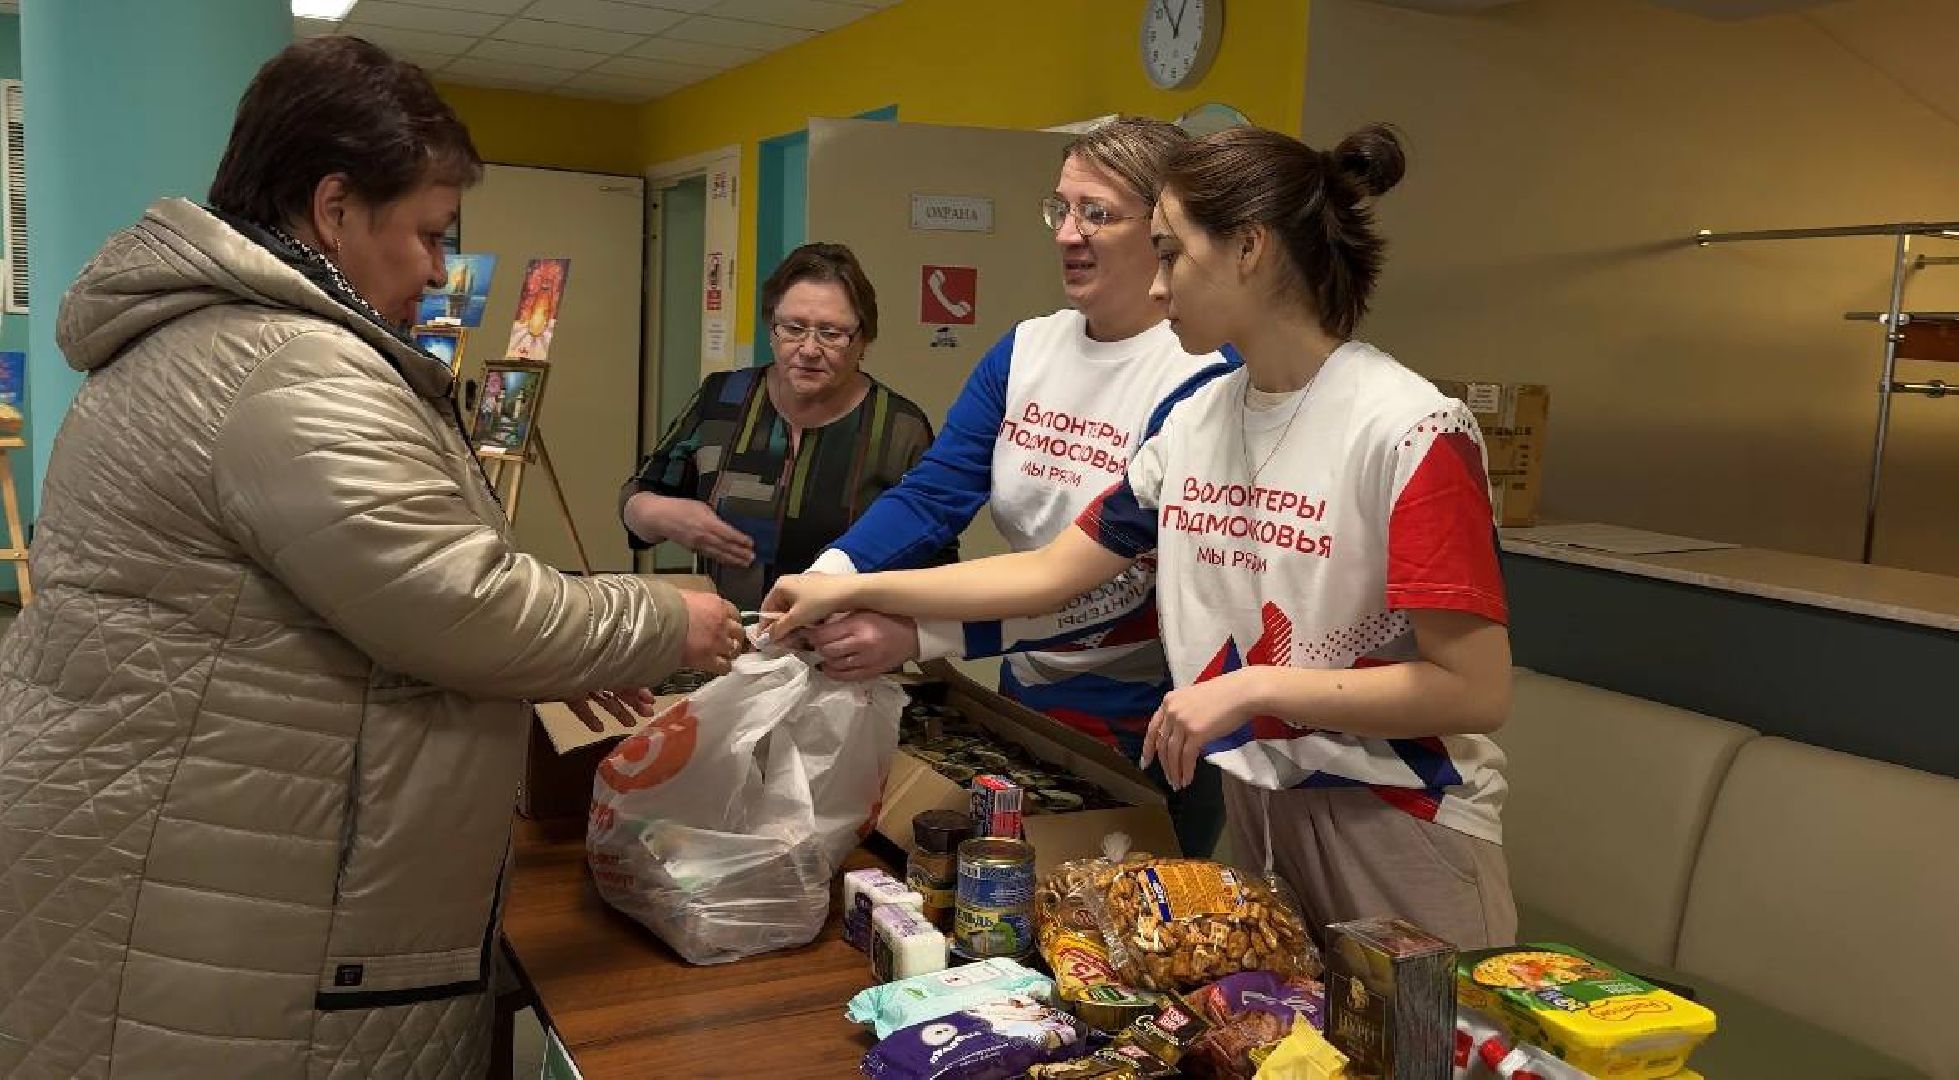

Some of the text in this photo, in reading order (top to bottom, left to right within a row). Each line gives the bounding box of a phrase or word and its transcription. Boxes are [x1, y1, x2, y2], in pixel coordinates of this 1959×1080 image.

[1022, 402, 1130, 448] ВЛОНТЕРЫ
[1183, 477, 1327, 522] ВОЛОНТЕРЫ
[1162, 504, 1333, 559] ПОДМОКОВЬЯ
[1196, 546, 1225, 567] МЫ
